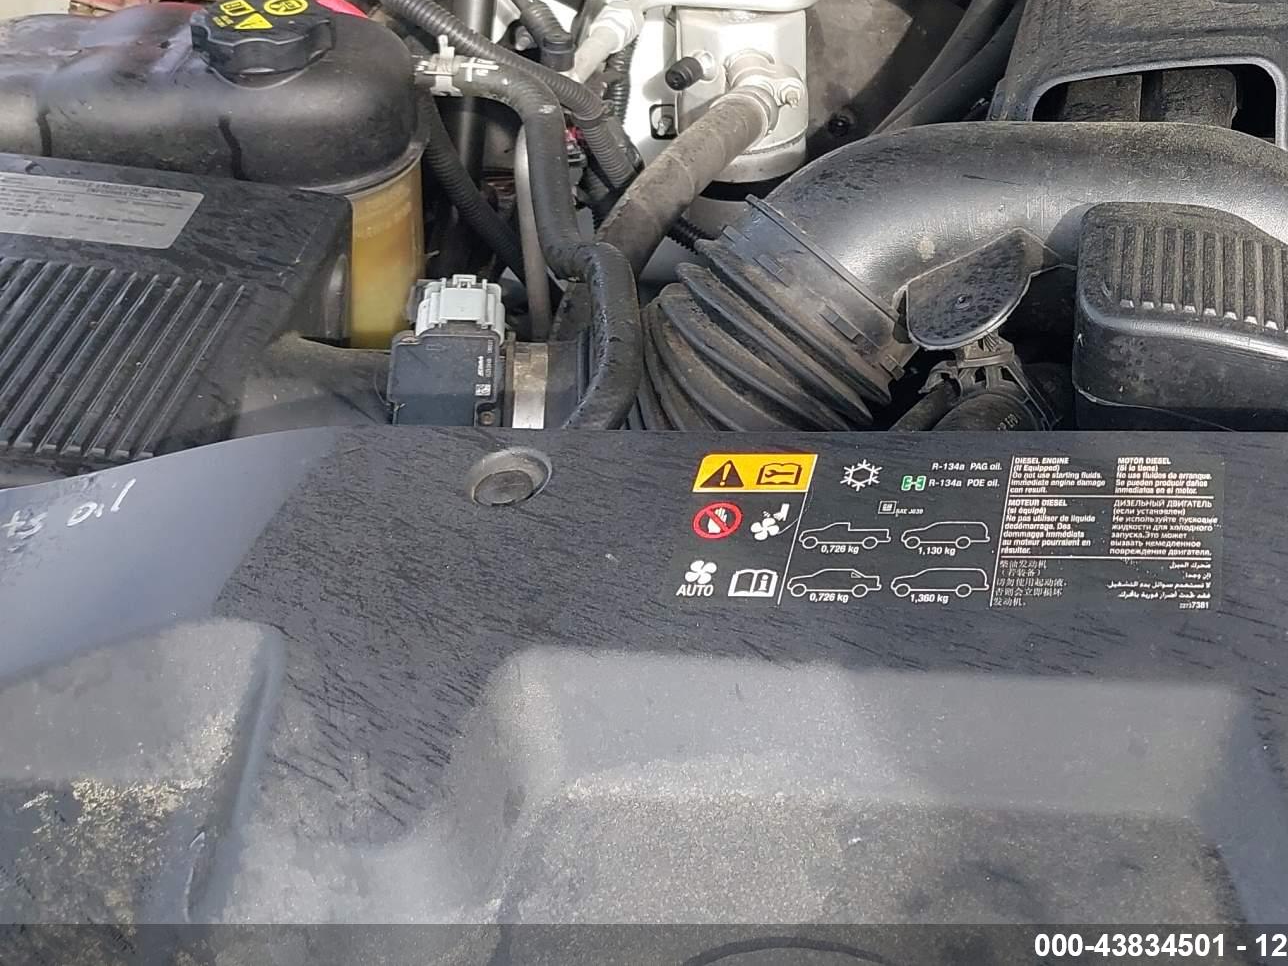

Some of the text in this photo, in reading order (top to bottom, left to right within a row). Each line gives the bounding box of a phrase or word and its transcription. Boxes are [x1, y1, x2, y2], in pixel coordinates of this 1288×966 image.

[931, 462, 1002, 471] R-134a PAG oil.
[1023, 465, 1060, 473] Equipped)
[1051, 472, 1079, 480] starting
[928, 479, 1000, 487] R-134a POE oil.
[1113, 499, 1213, 507] ДИЗЕЛЬНЫЙ ДВИГАТЕЛЬ
[1017, 515, 1031, 523] pas
[1041, 539, 1080, 547] pourraient
[820, 545, 859, 554] 0,726 kg
[918, 547, 956, 556] 1,130 kg
[1109, 548, 1166, 556] повреждение
[675, 584, 714, 596] AUTO
[809, 593, 849, 603] 0,726 kg
[937, 594, 949, 604] kg
